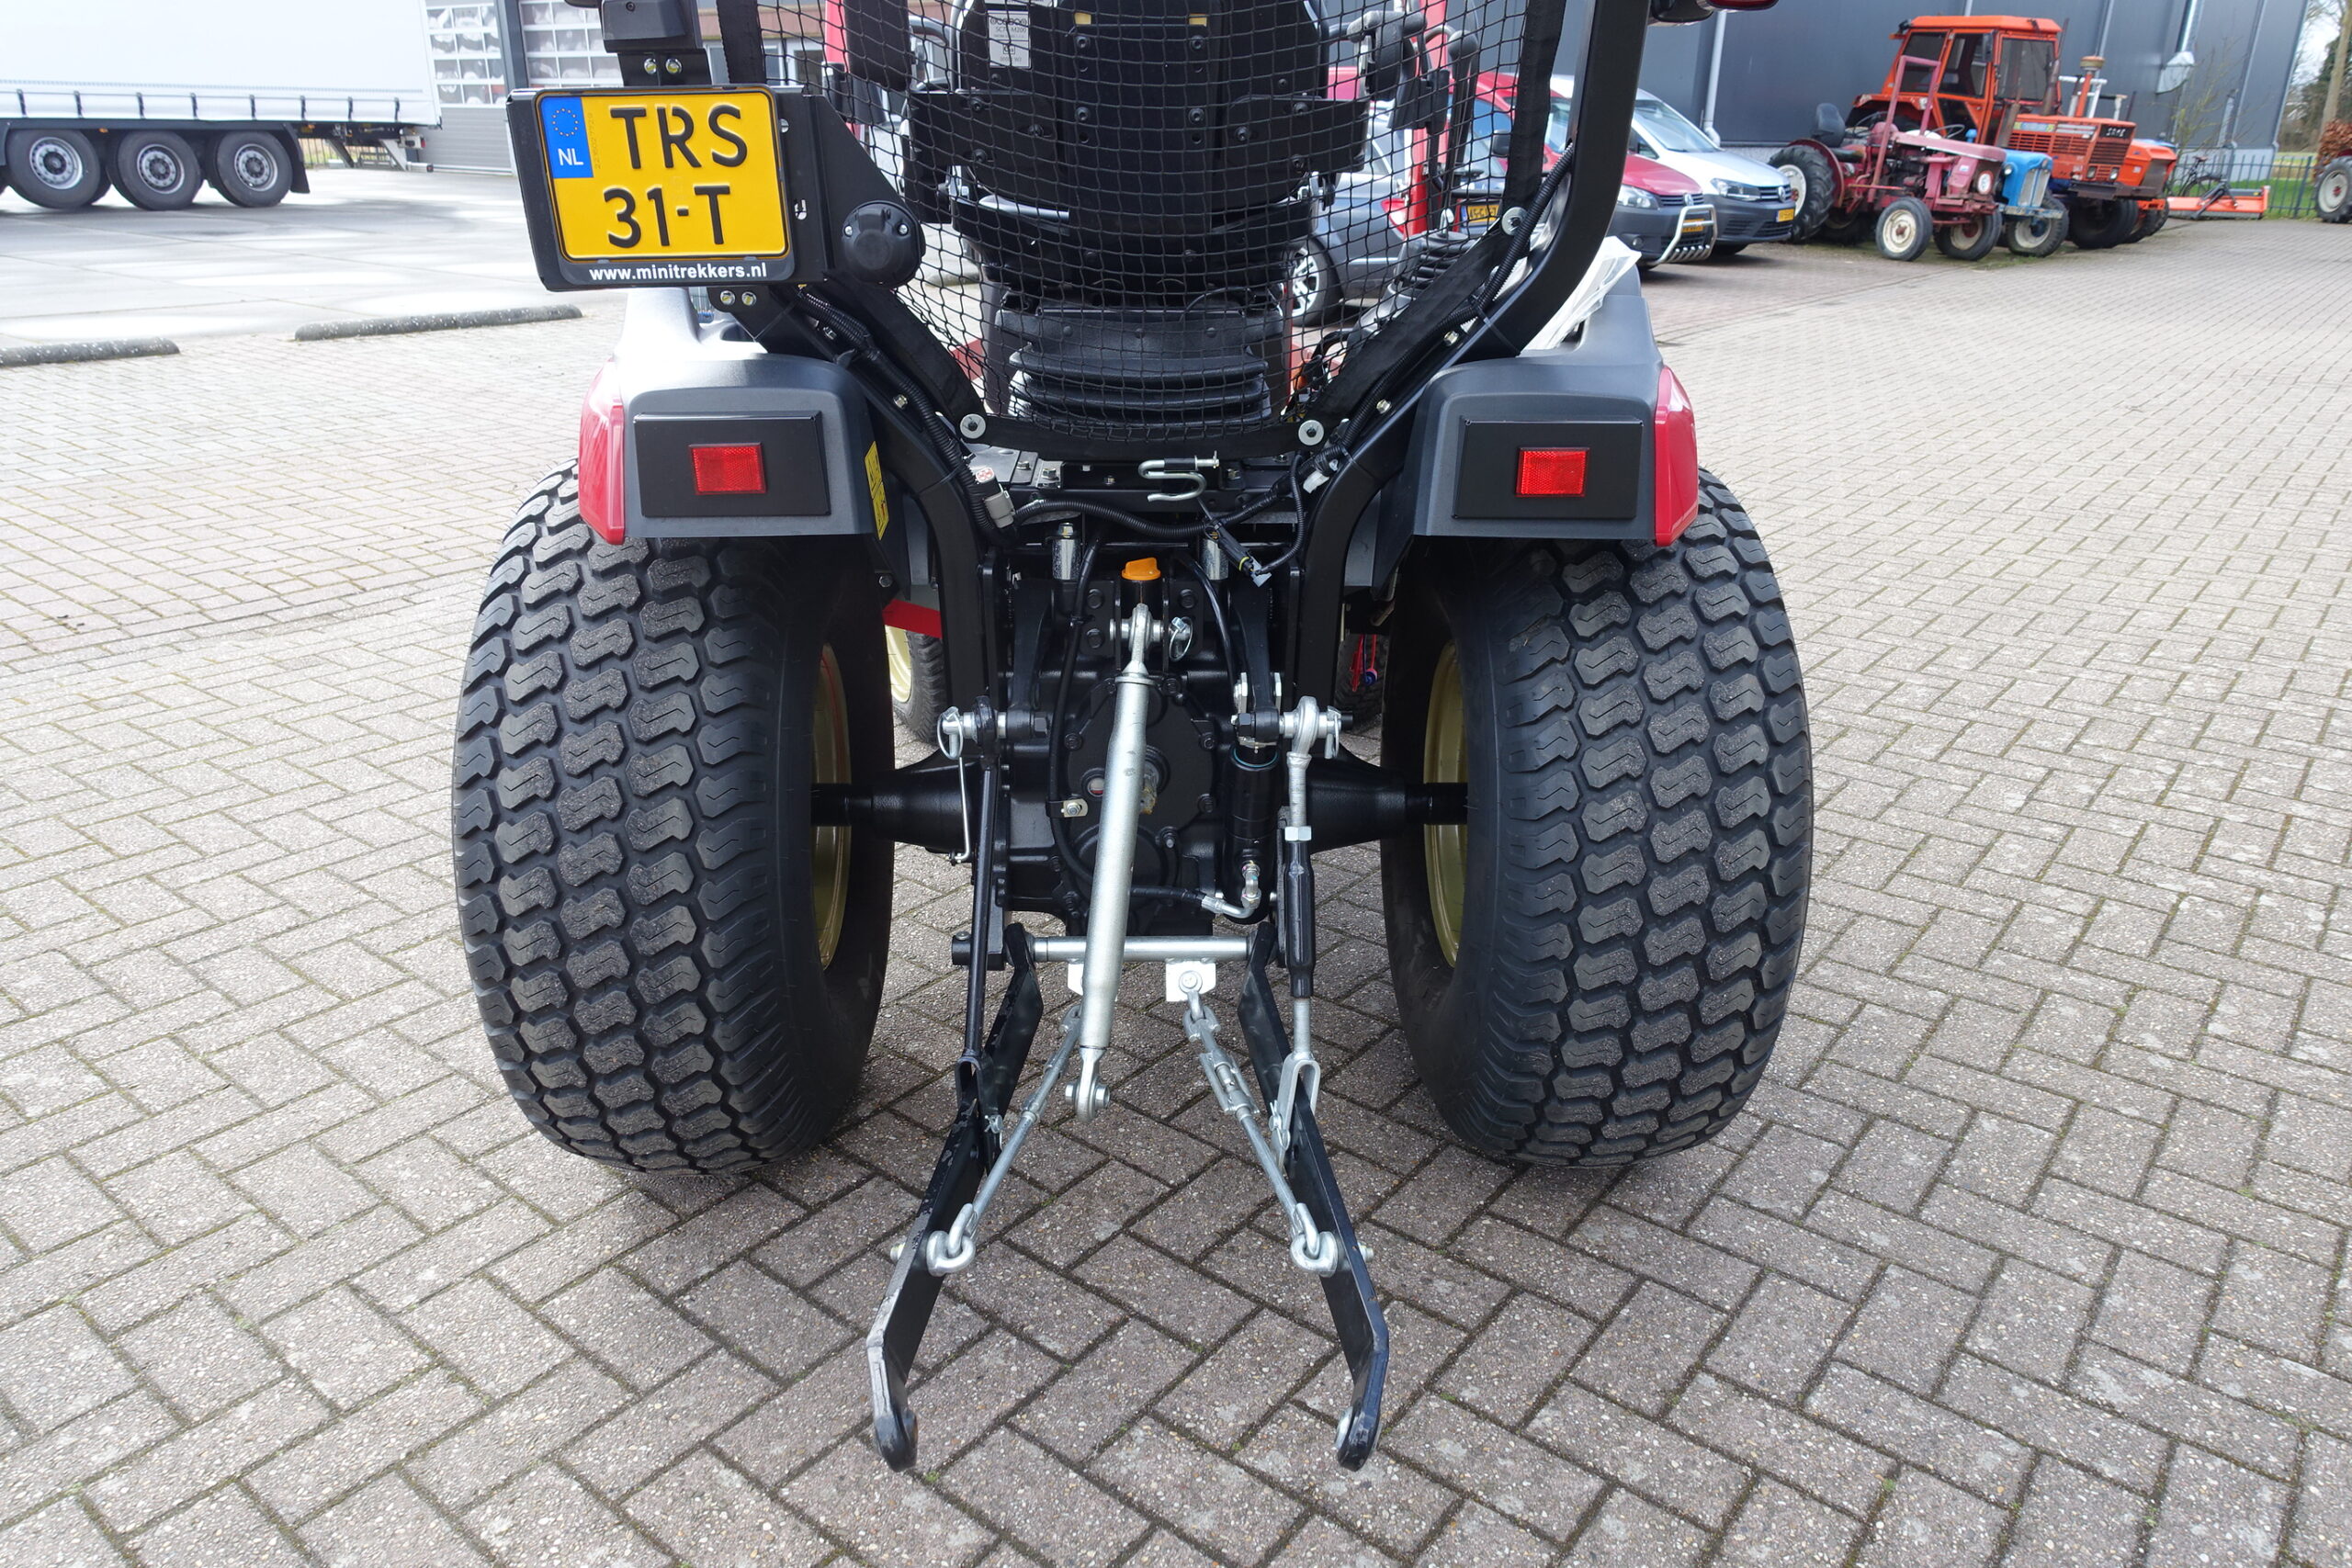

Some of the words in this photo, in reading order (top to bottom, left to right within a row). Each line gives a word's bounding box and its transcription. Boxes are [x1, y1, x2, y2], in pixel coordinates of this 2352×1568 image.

[558, 148, 584, 166] NL
[609, 104, 748, 170] TRS
[603, 185, 731, 248] 31-T
[589, 263, 767, 281] www.minitrekkers.nl
